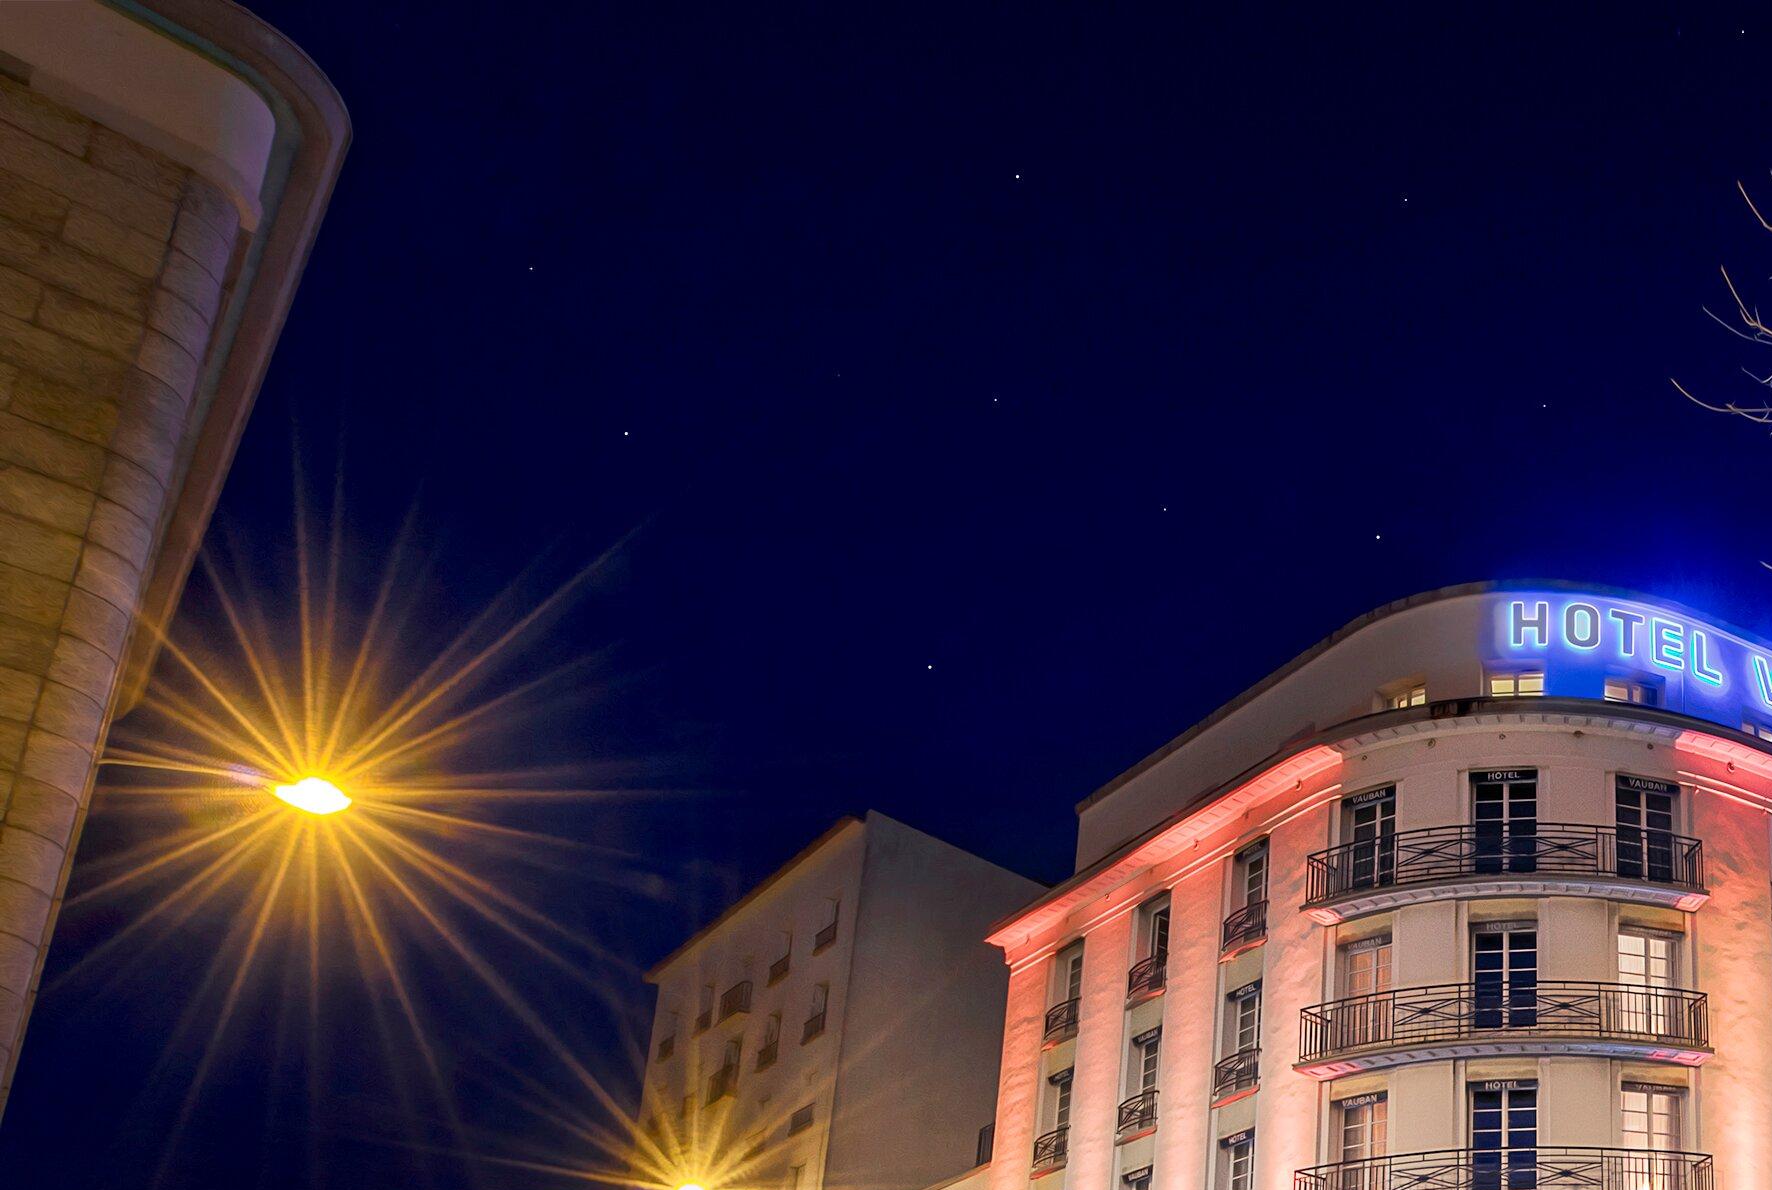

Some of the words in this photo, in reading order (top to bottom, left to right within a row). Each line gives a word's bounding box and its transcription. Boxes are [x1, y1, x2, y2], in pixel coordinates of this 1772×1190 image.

[1510, 600, 1723, 687] HOTEL
[1487, 771, 1520, 781] HOTEL
[1628, 777, 1668, 792] VAUBAN
[1352, 789, 1386, 804] VAUBAN
[1486, 922, 1517, 931] HOTEL
[1347, 936, 1383, 950] VAUBAN
[1236, 984, 1257, 998] HOTEL
[1485, 1080, 1519, 1091] HOTEL
[1341, 1094, 1378, 1107] VAUBAN
[1228, 1131, 1246, 1144] HOTEL
